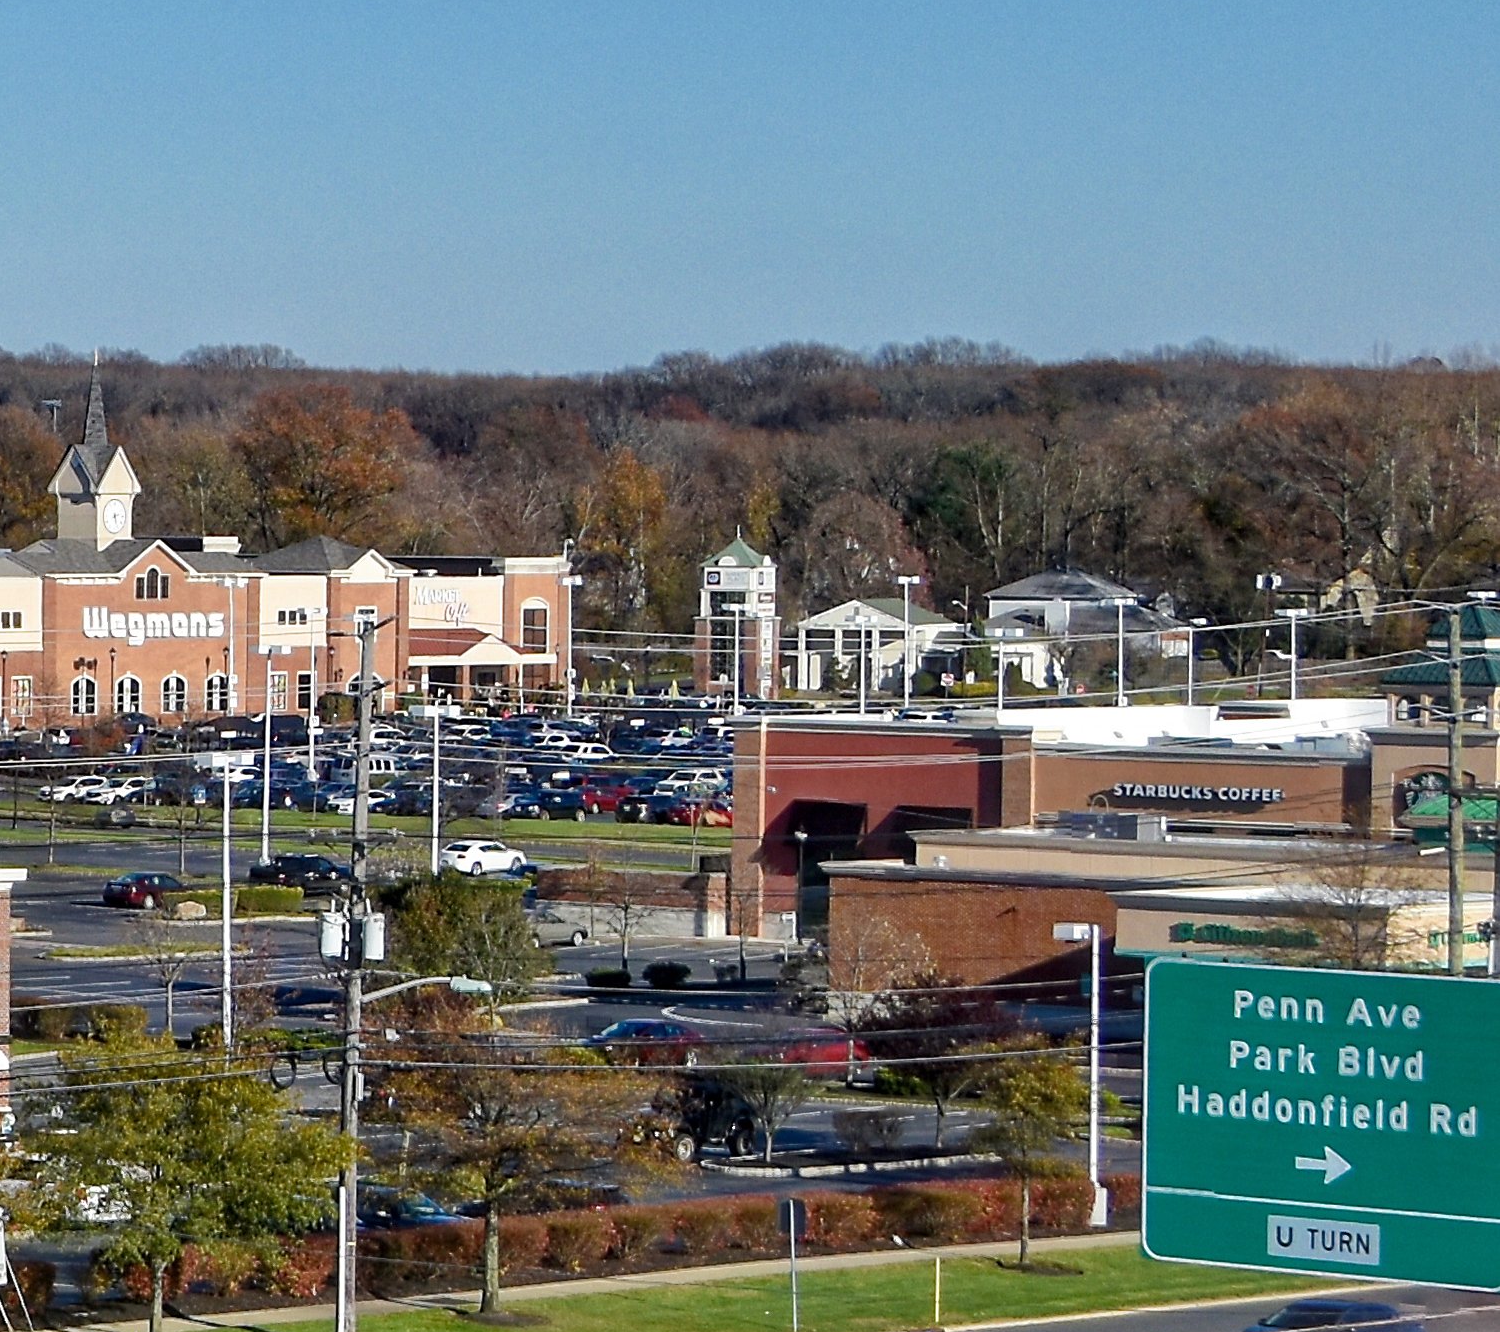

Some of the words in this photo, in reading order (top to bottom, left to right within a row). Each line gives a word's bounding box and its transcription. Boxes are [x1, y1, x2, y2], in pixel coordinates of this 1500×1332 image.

[83, 606, 225, 646] Wegmans
[1113, 783, 1213, 800] STARBUCKS
[1218, 786, 1281, 802] COFFEE
[1234, 990, 1324, 1023] Penn
[1346, 998, 1421, 1029] Ave
[1229, 1040, 1316, 1074] Park
[1338, 1045, 1424, 1081] Blvd
[1177, 1084, 1409, 1132] Haddonfield
[1429, 1103, 1478, 1137] Rd
[1276, 1225, 1293, 1248] U
[1307, 1228, 1371, 1255] TURN
